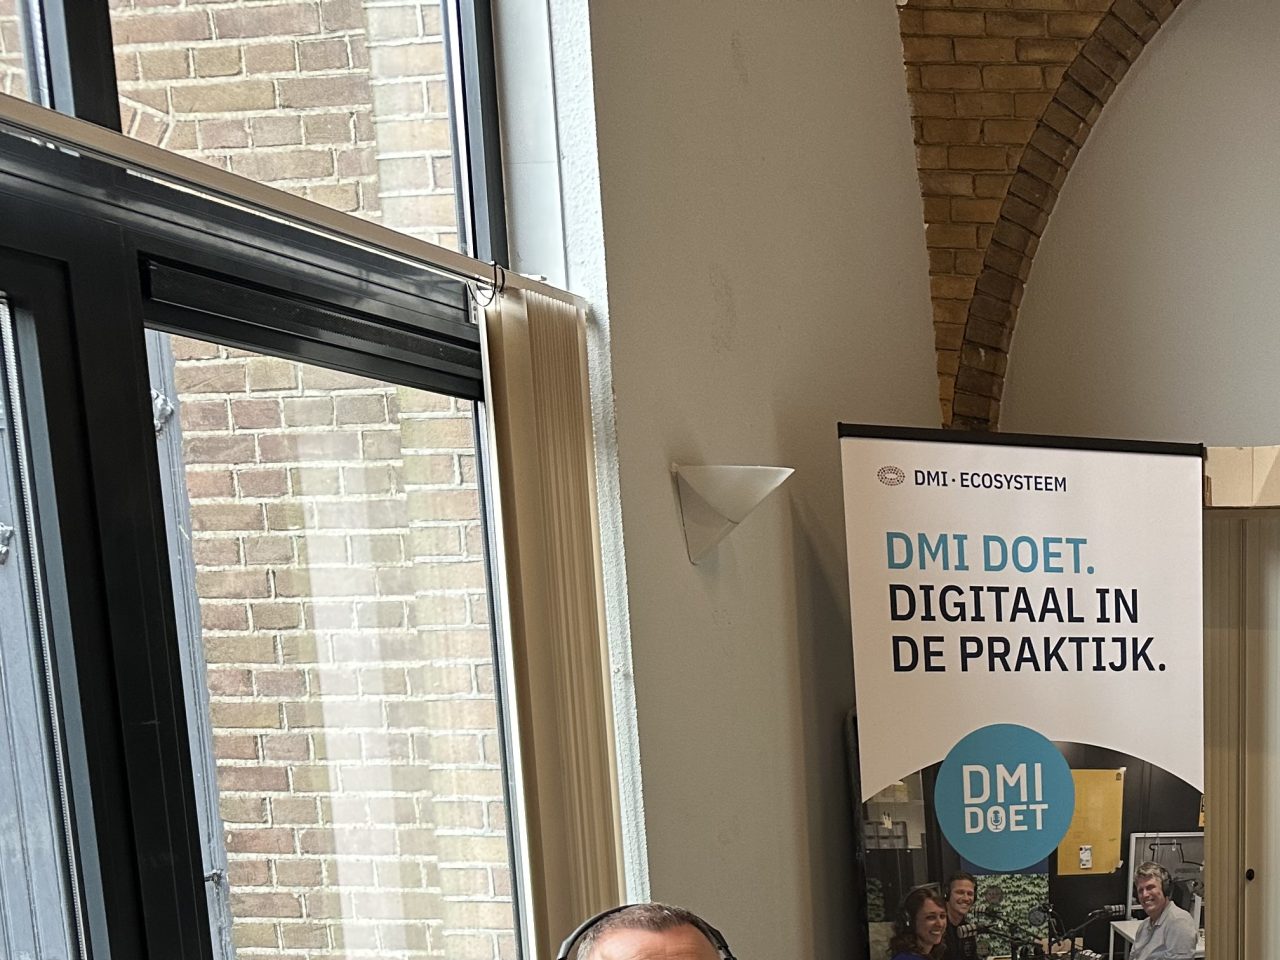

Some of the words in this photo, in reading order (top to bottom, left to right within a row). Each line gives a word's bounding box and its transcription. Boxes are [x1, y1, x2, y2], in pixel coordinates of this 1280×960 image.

[914, 469, 948, 487] DMI
[959, 471, 1067, 492] ECOSYSTEEM
[886, 531, 970, 571] DMI
[982, 534, 1095, 574] DOET.
[889, 584, 1085, 623] DIGITAAL
[1095, 588, 1138, 623] IN
[891, 635, 946, 673] DE
[959, 636, 1166, 673] PRAKTIJK.
[962, 763, 1043, 805] DMI
[964, 803, 1049, 834] DOET
